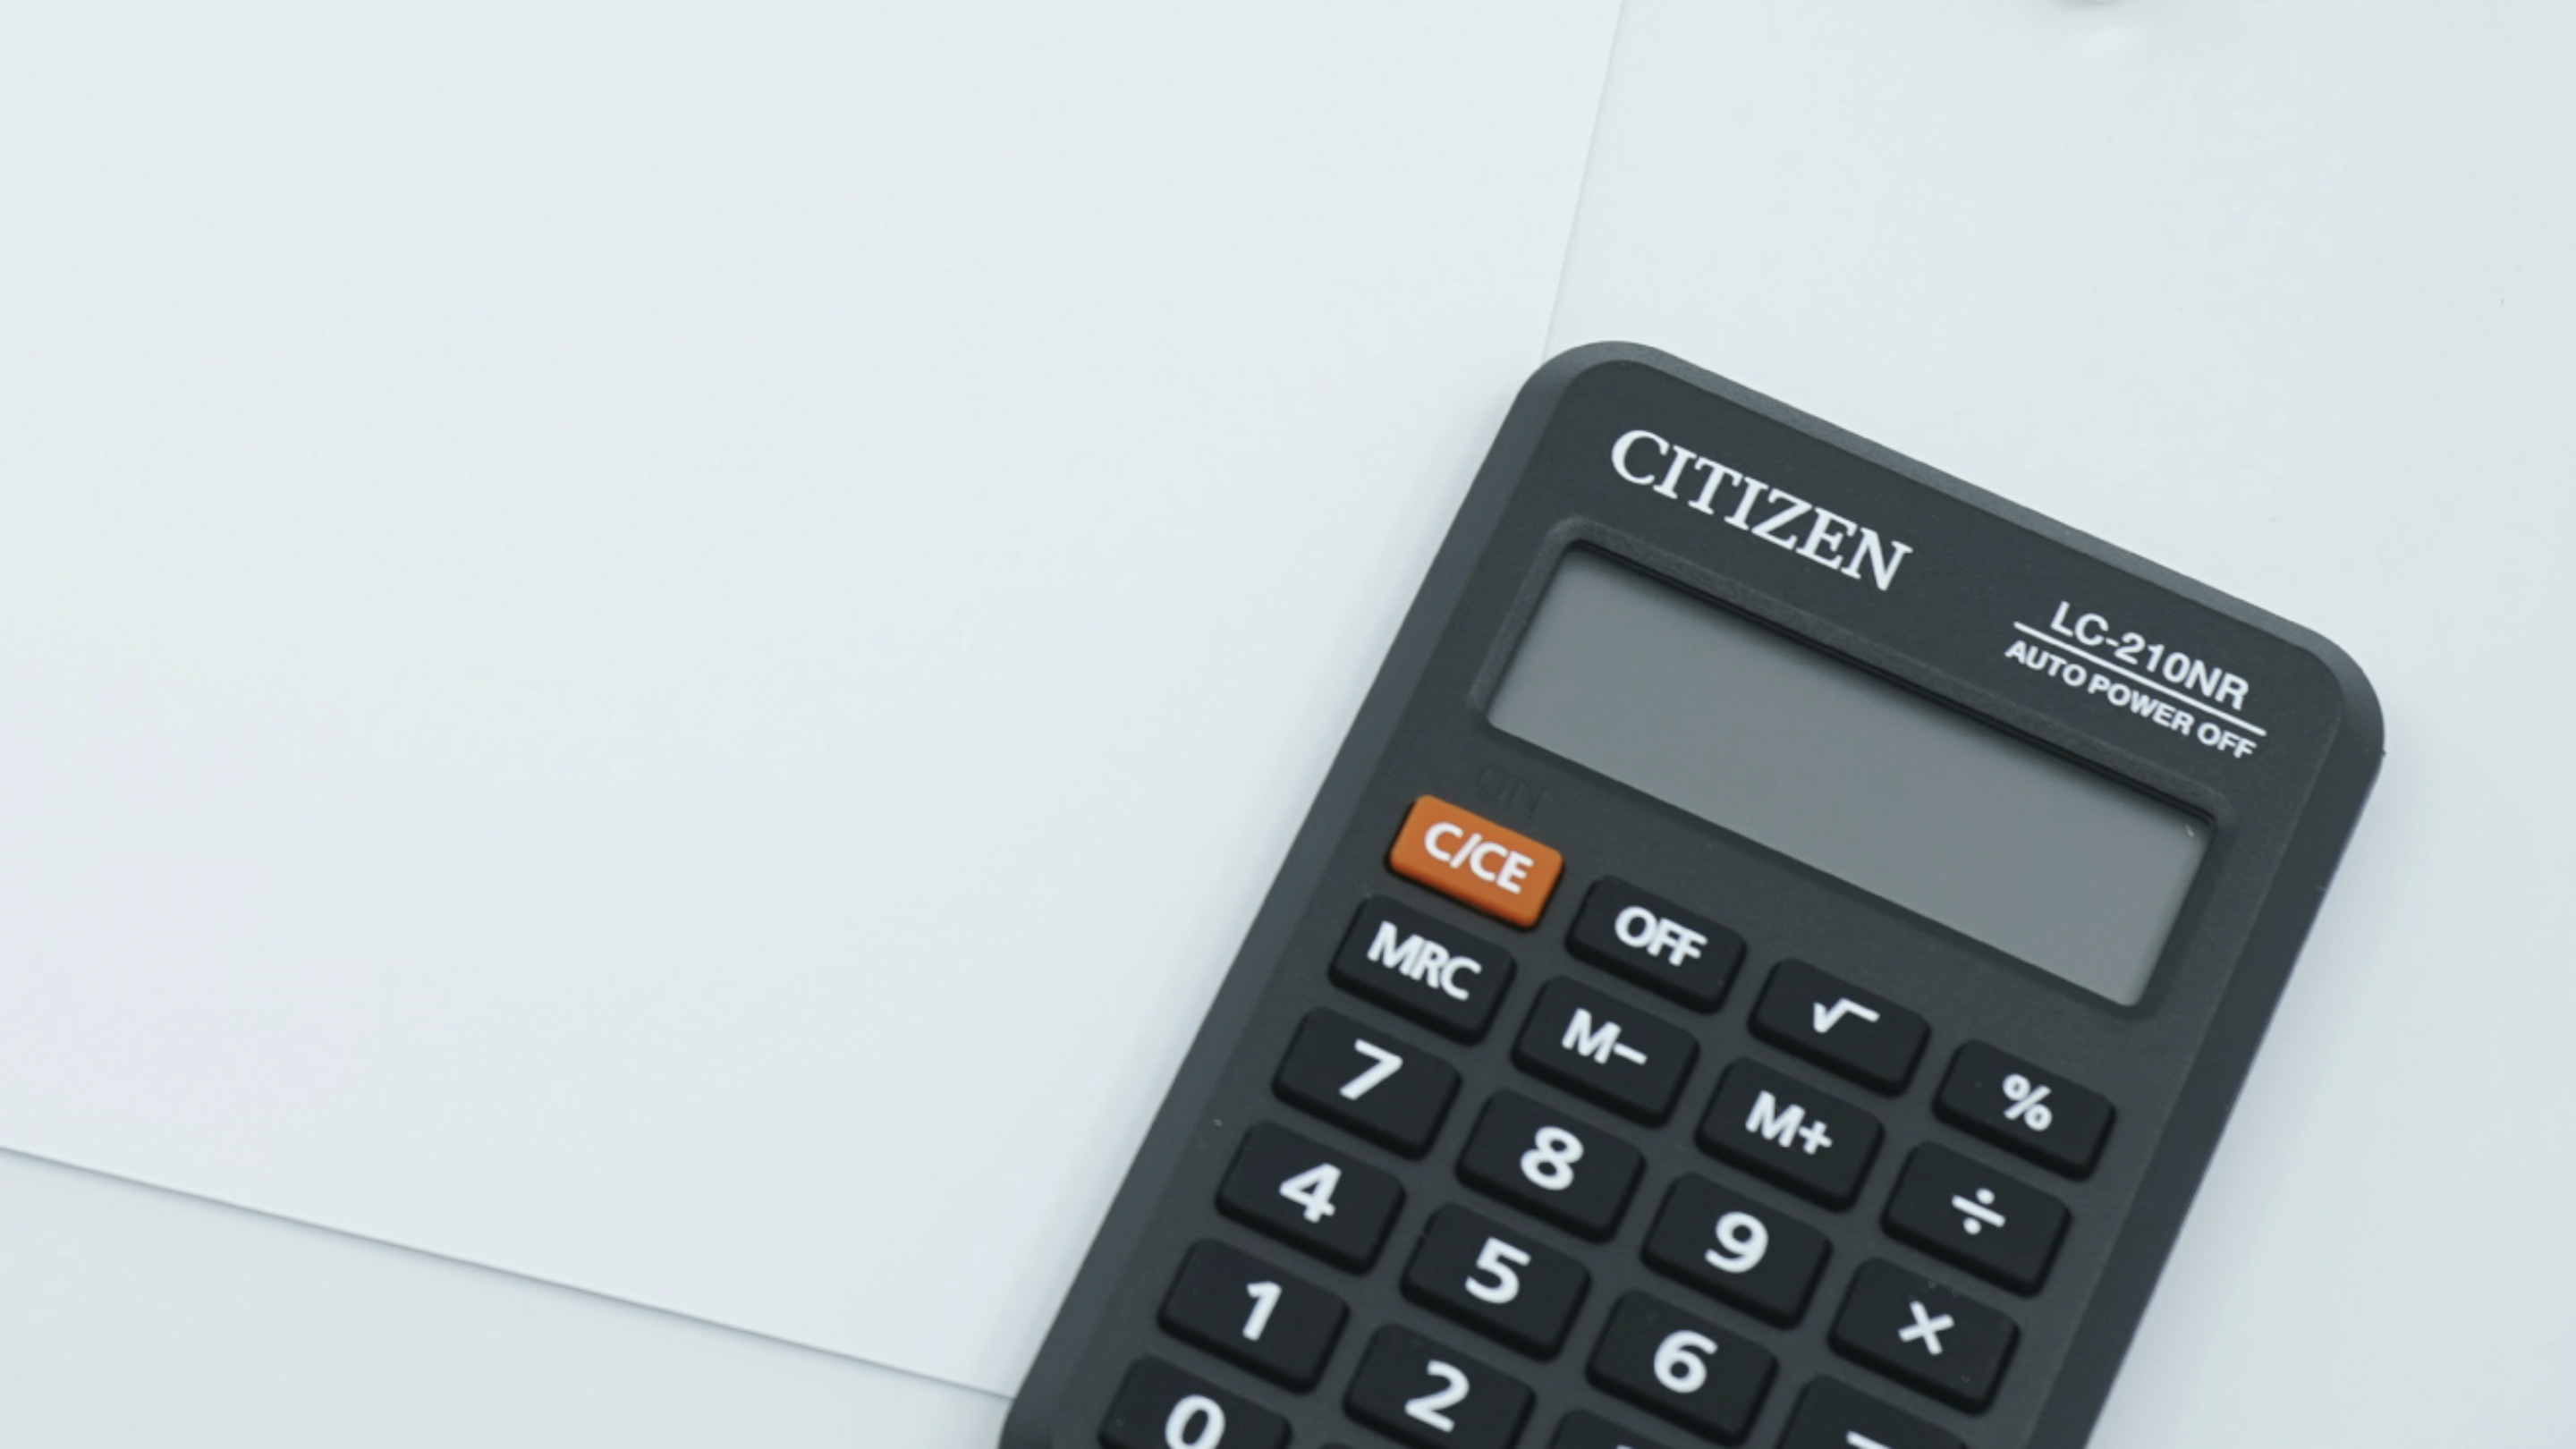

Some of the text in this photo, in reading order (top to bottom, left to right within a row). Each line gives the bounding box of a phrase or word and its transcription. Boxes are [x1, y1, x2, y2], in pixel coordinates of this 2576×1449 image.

[1611, 428, 1912, 591] CITIZEN
[2049, 599, 2250, 712] LC-210NR
[2004, 639, 2258, 759] AUTO POWER OFF
[1423, 820, 1537, 895] C/CE
[1367, 920, 1482, 1000] MRC
[1614, 906, 1707, 966] OFF
[1340, 1039, 1403, 1099] 7
[1745, 1090, 1832, 1154] M+
[2003, 1074, 2052, 1131] %
[1521, 1126, 1583, 1191] 8
[1279, 1164, 1341, 1223] 4
[1465, 1237, 1530, 1303] 5
[1706, 1212, 1768, 1273] 9
[1242, 1282, 1282, 1341] 1
[1654, 1330, 1717, 1393] 6
[1165, 1395, 1225, 1449] 0
[1405, 1360, 1470, 1432] 2
